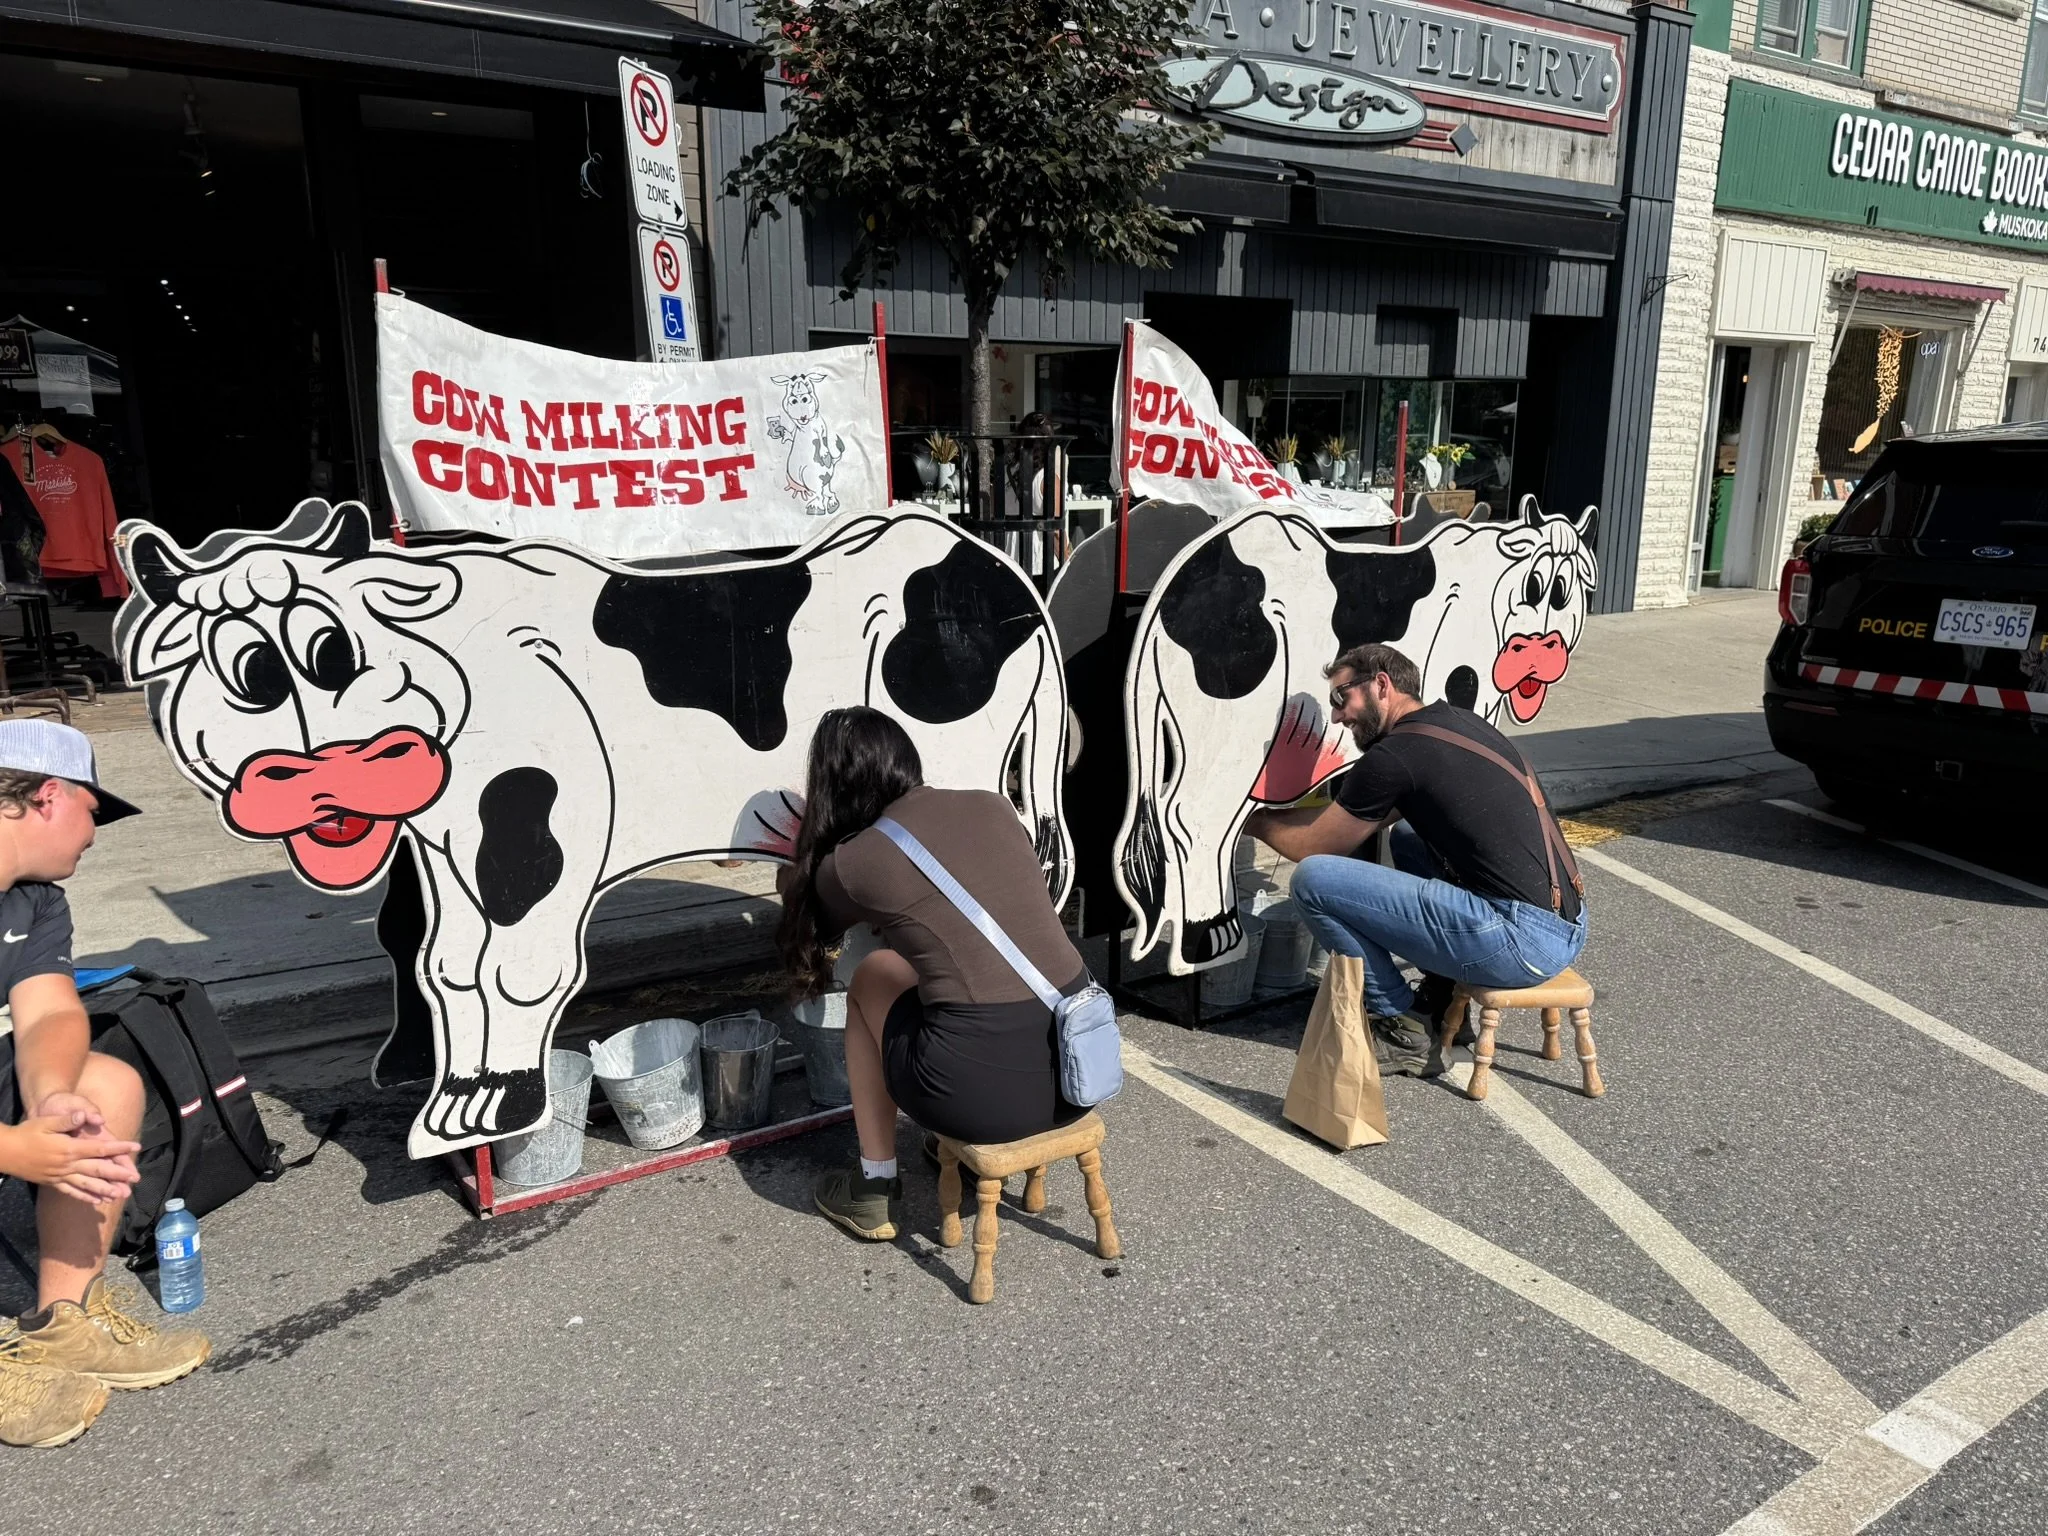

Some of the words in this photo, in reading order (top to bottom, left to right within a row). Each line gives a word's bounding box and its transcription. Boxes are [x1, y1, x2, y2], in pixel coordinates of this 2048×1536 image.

[1293, 0, 1596, 100] JEWELLERY
[1197, 54, 1409, 129] Design
[1832, 112, 1914, 184] CEDAR
[1916, 130, 1991, 198] CANOE
[636, 155, 676, 183] LOADING
[646, 184, 671, 205] ZONE
[1998, 213, 2048, 240] MUSKOKA
[657, 343, 667, 355] BY
[670, 345, 695, 358] PERMIT
[1920, 341, 1941, 359] open
[411, 370, 510, 445] COW
[520, 397, 748, 451] MILKING
[411, 440, 755, 509] CONTEST
[1969, 603, 2007, 613] ONTARIO
[1859, 618, 1928, 638] POLICE
[1939, 611, 1985, 635] CSCS
[1993, 615, 2030, 638] 965
